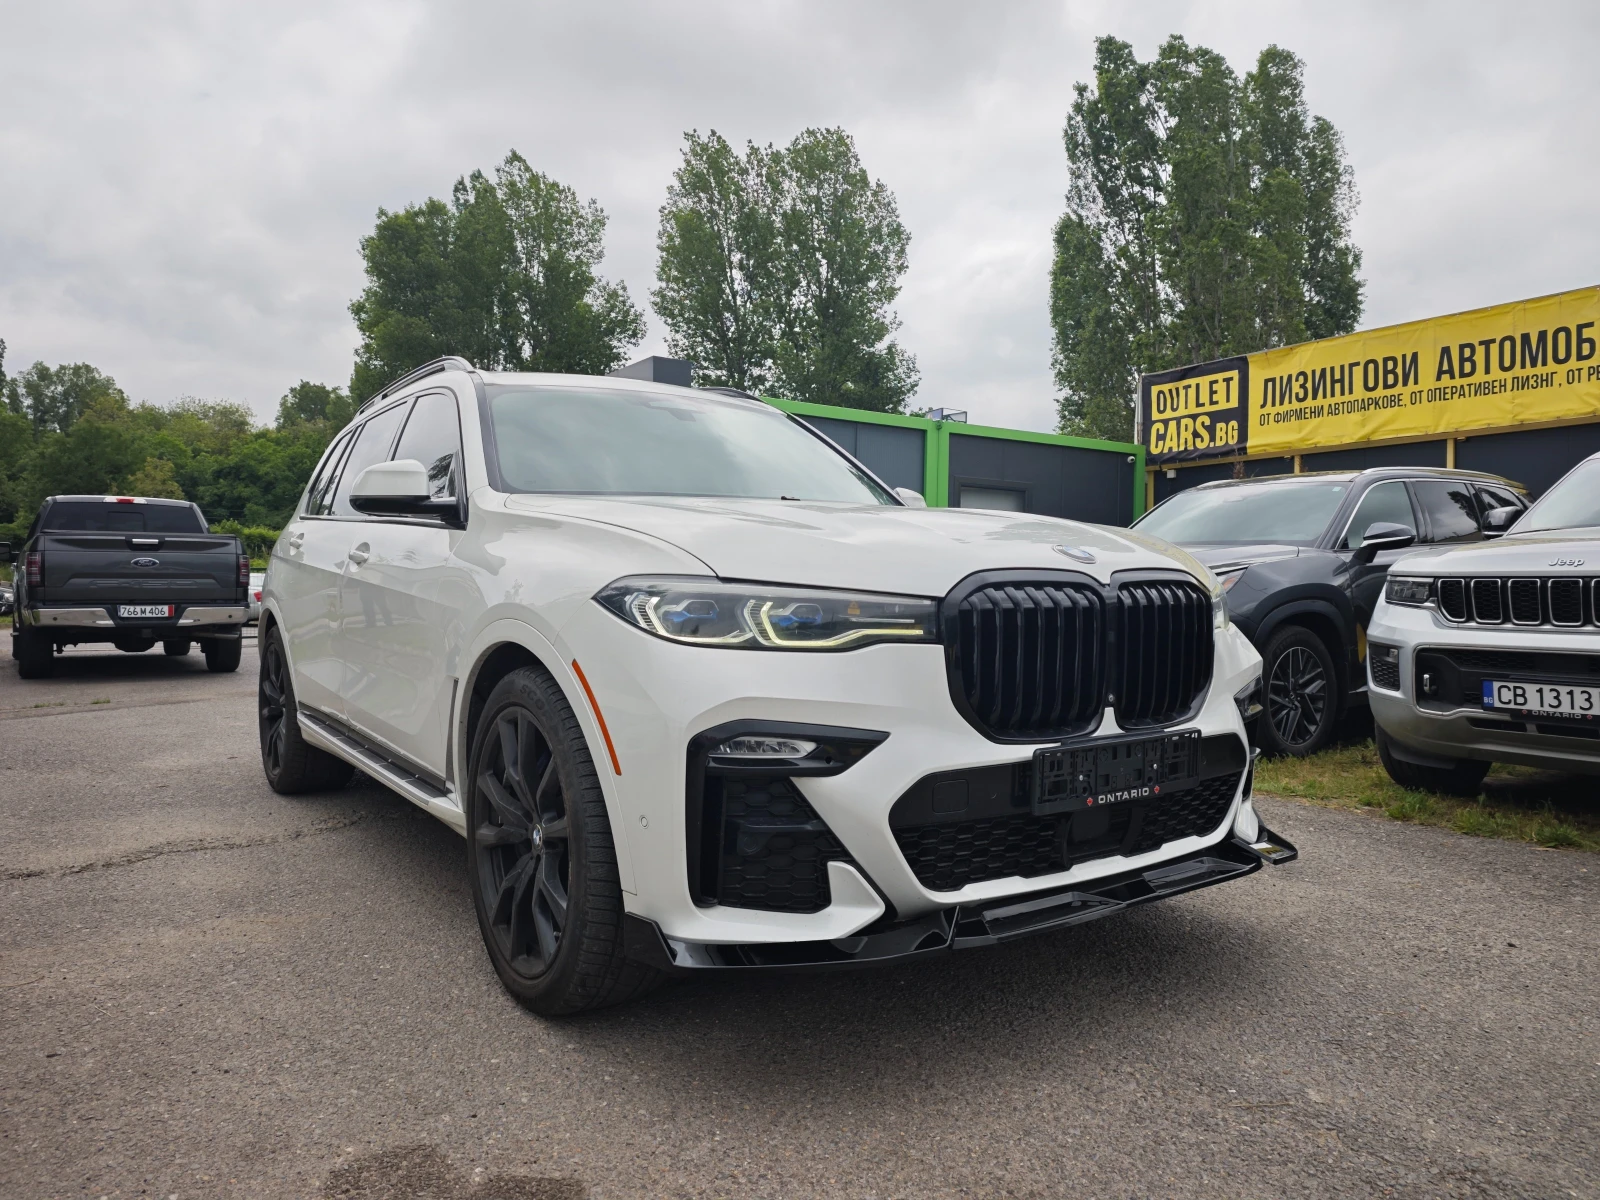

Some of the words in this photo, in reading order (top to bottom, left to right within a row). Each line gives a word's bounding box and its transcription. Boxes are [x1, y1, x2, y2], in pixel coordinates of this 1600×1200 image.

[1260, 351, 1419, 410] ЛИЗИНГОВИ
[1435, 321, 1596, 382] АВТОМОБ
[1156, 376, 1234, 415] OUTLET
[1259, 412, 1272, 427] ОТ
[1273, 404, 1324, 424] ФИРМЕНИ
[1326, 393, 1407, 417] АВТОПАРКОВЕ,
[1410, 389, 1424, 406] ОТ
[1426, 378, 1507, 403] ОПЕРАТИВЕН
[1566, 367, 1584, 385] ОТ
[1149, 414, 1239, 455] CARS.BG
[1548, 557, 1586, 568] Jeep
[121, 606, 139, 616] 766
[140, 607, 147, 616] M
[148, 606, 166, 616] 406
[1483, 696, 1494, 704] BG
[1497, 684, 1528, 706] CB
[1535, 687, 1594, 711] 1313
[1531, 709, 1582, 719] ONTARIO
[1098, 787, 1150, 804] ONTARIO
